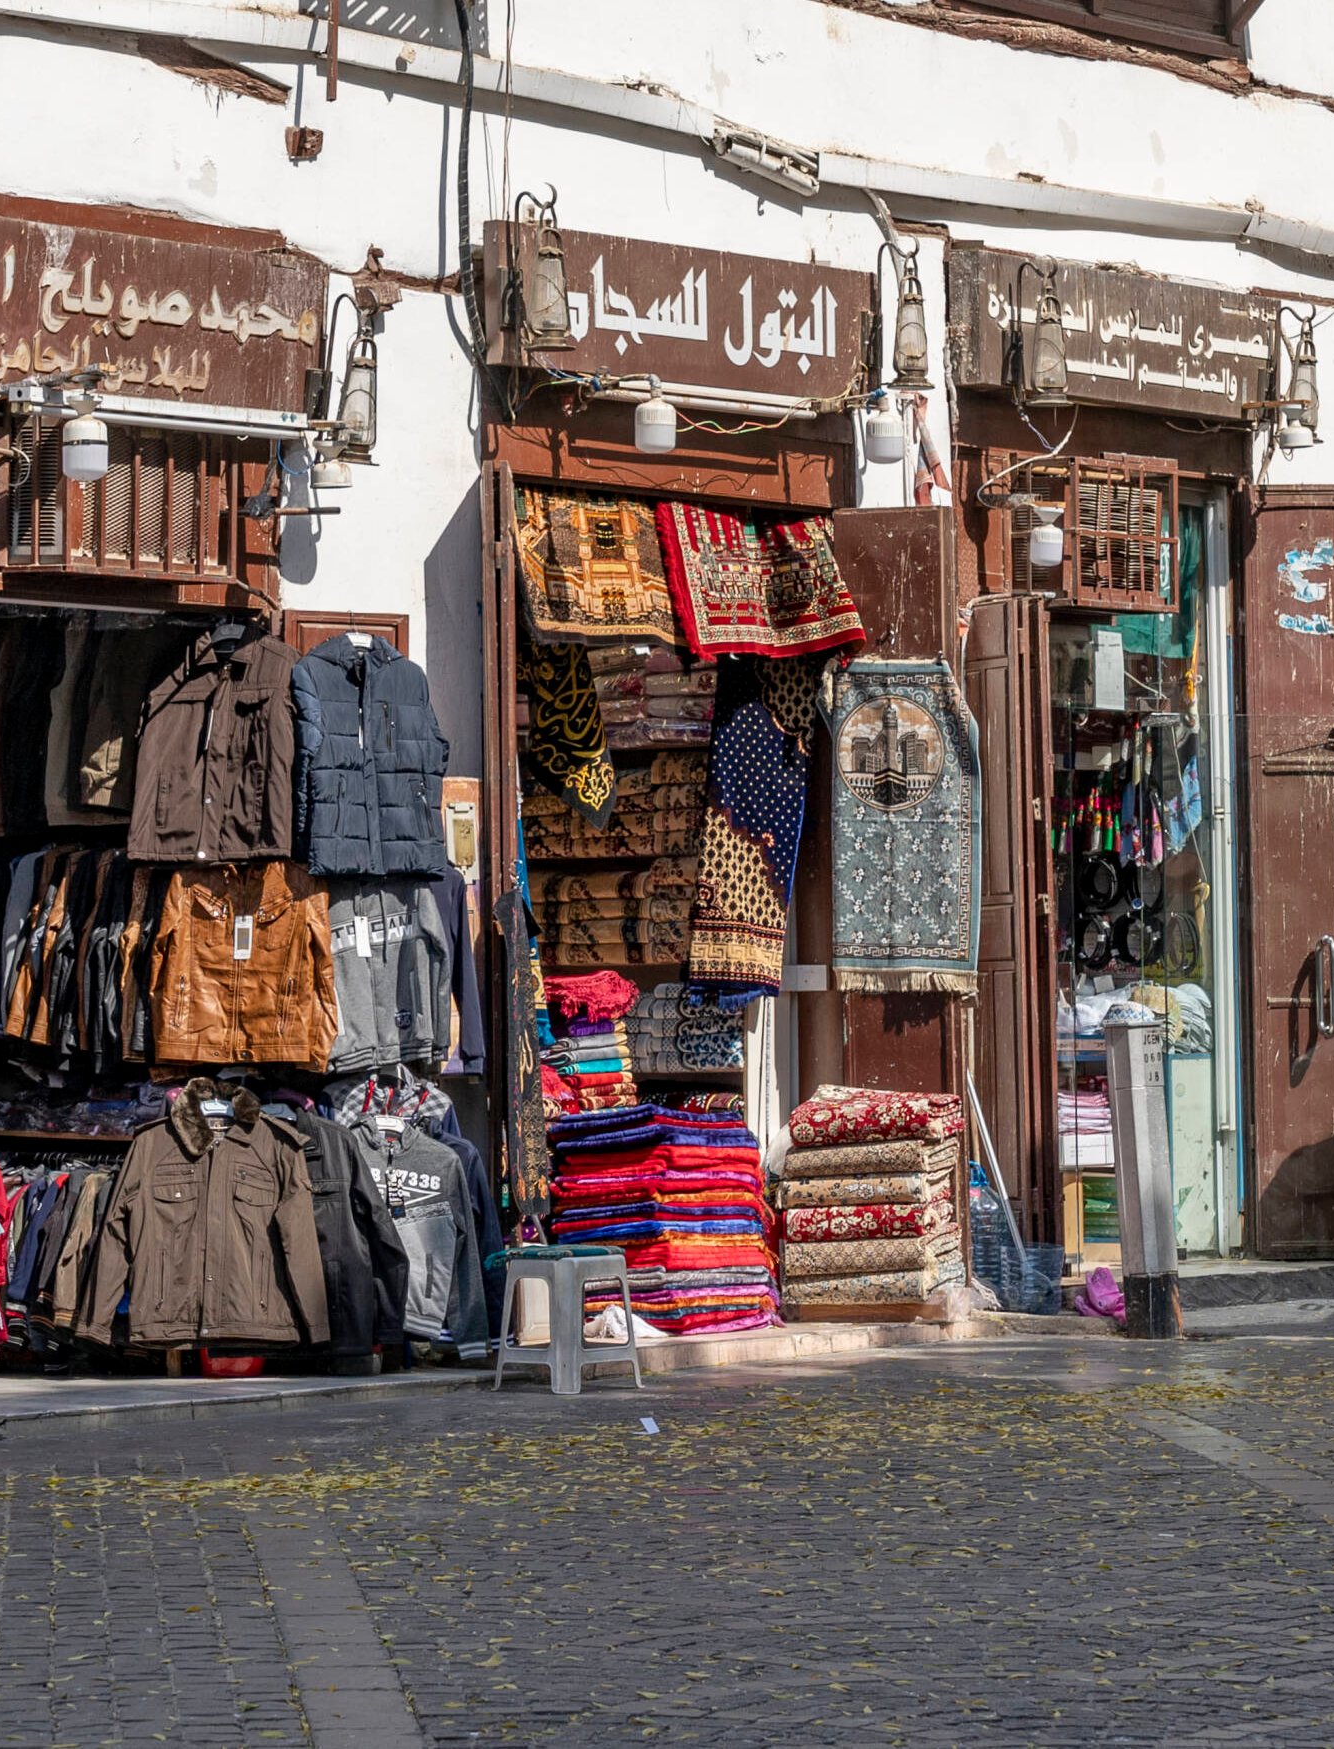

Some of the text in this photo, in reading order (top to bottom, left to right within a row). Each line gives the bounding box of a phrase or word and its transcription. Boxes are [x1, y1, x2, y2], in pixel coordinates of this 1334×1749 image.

[40, 256, 194, 338] صويلح
[200, 285, 318, 346] محمد
[724, 274, 838, 375] البتول
[1099, 307, 1183, 347] للملابس
